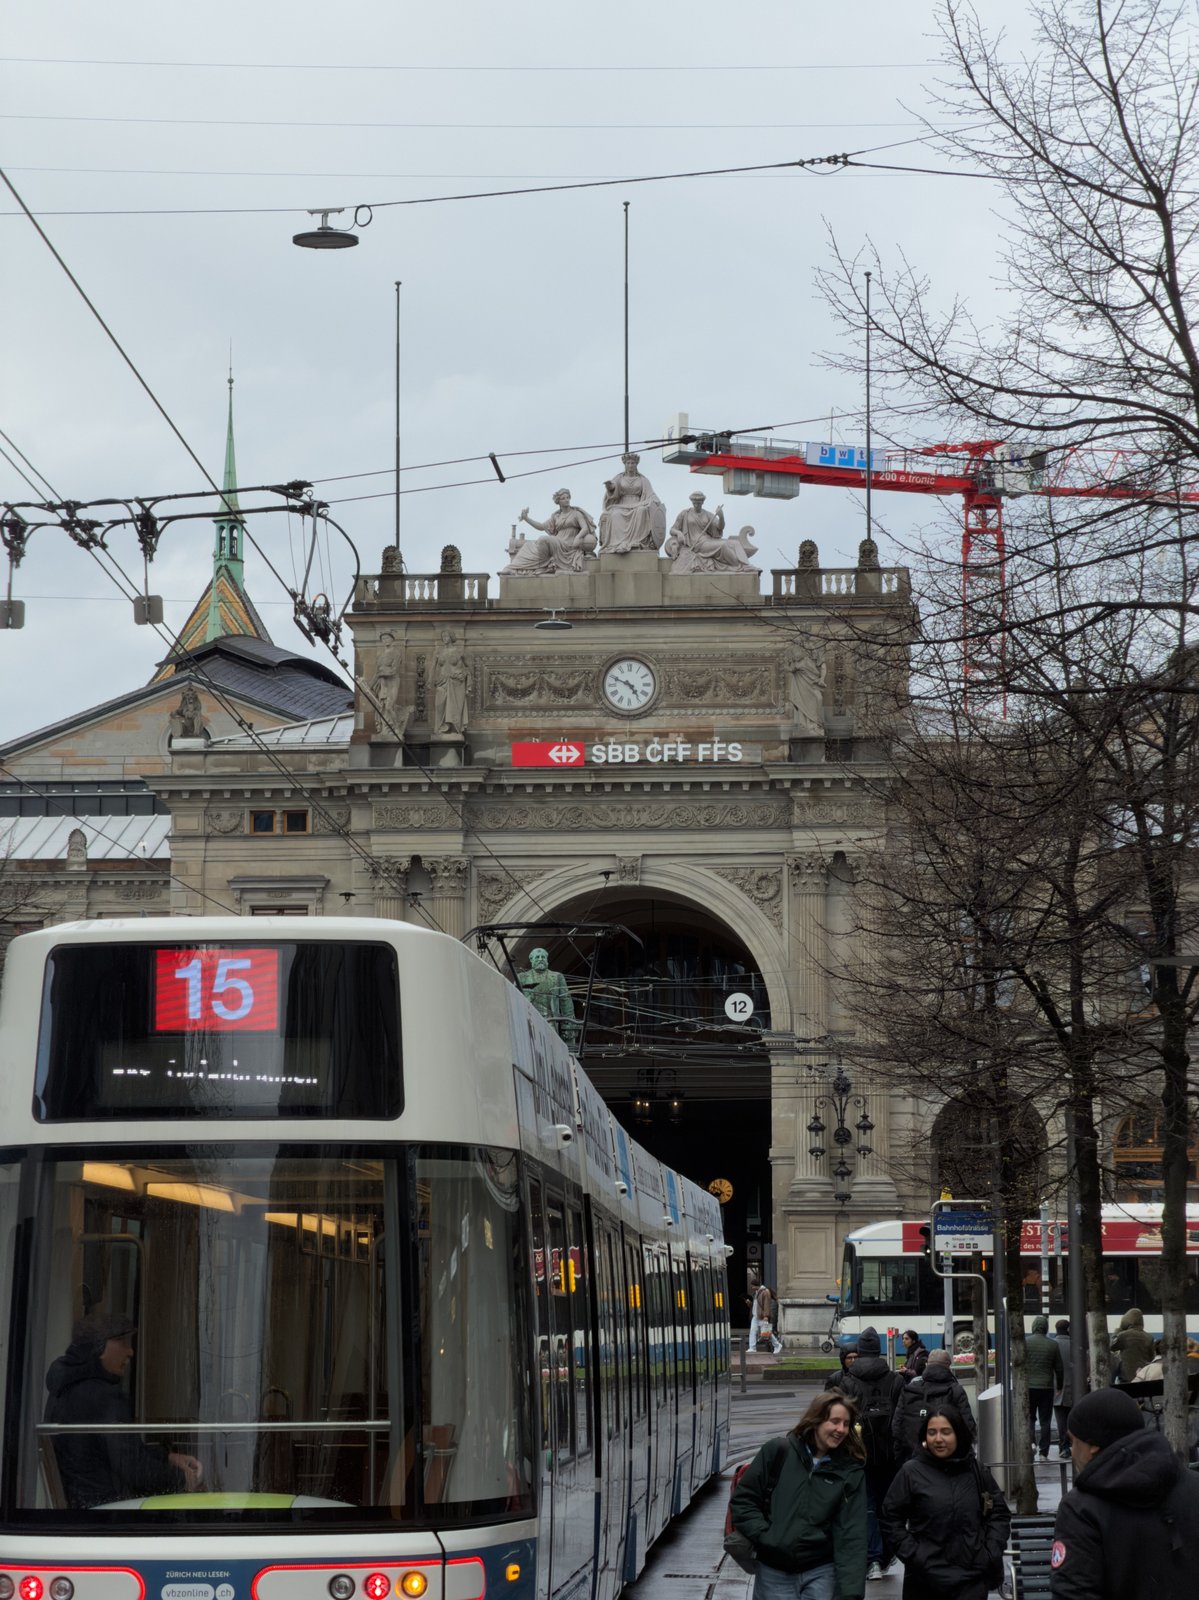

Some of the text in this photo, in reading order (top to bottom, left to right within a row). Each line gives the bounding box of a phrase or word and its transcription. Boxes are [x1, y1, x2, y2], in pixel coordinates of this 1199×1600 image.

[879, 472, 897, 481] 200
[900, 474, 935, 485] e.tronic
[591, 743, 743, 763] SBB CFF FFS
[175, 959, 254, 1020] 15
[731, 1000, 747, 1013] 12
[166, 1589, 209, 1598] vbzonline
